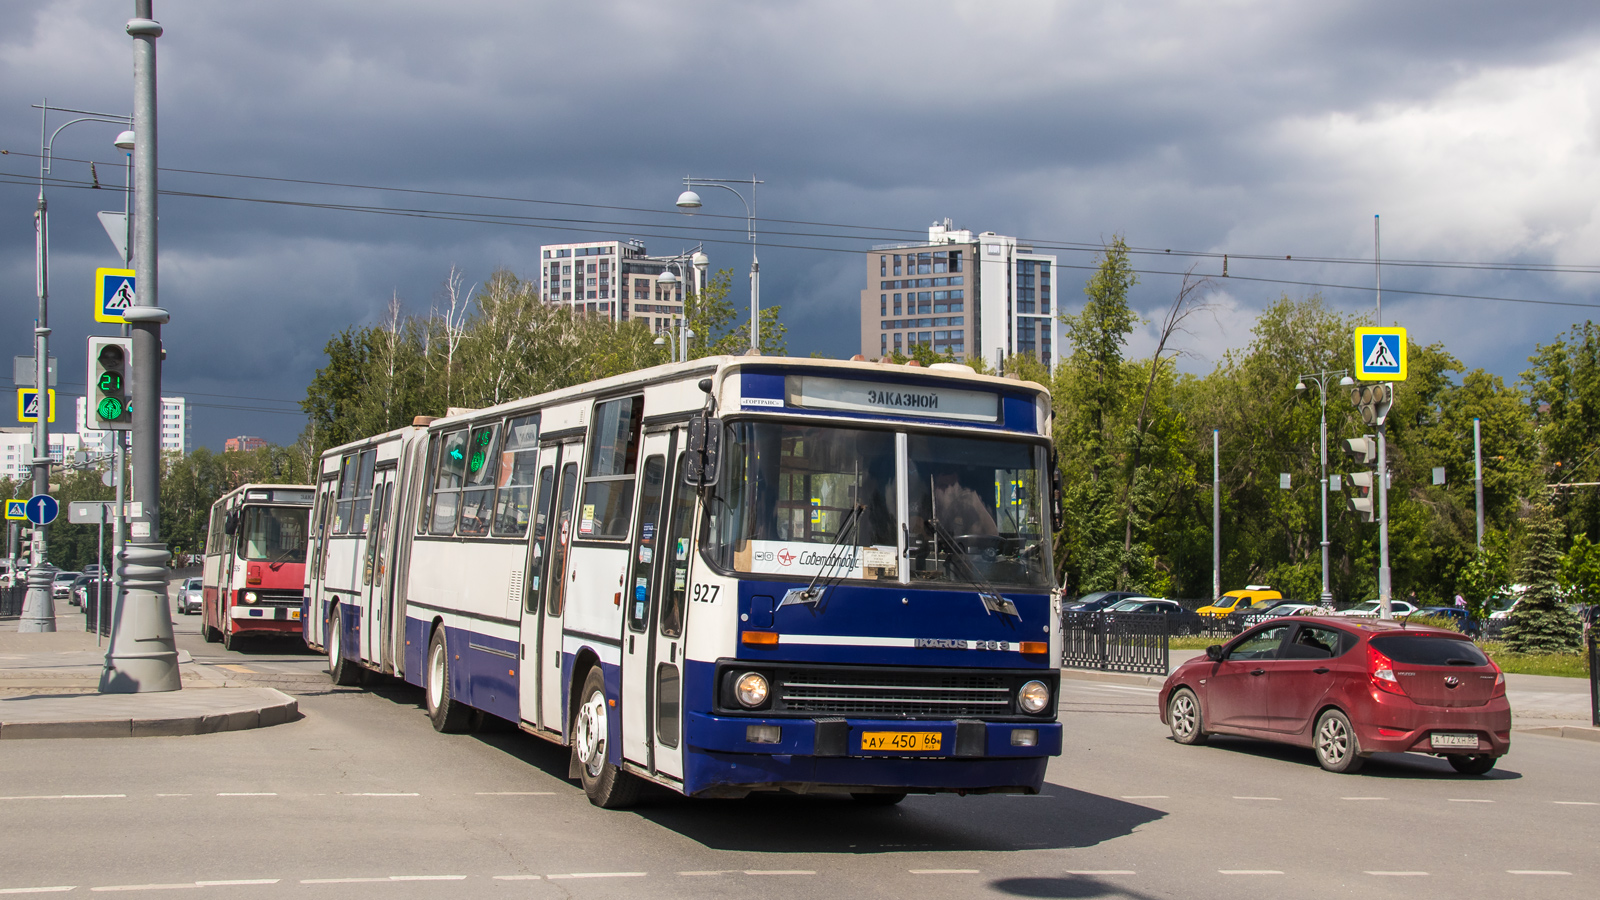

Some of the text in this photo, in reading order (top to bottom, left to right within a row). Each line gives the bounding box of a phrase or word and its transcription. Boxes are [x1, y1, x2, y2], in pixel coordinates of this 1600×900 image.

[101, 374, 120, 391] 21
[867, 390, 938, 408] ЗАКАЗНОЙ
[693, 583, 720, 603] 927
[914, 638, 1010, 651] IKARUS 283
[892, 735, 916, 748] 450
[924, 734, 937, 744] 66
